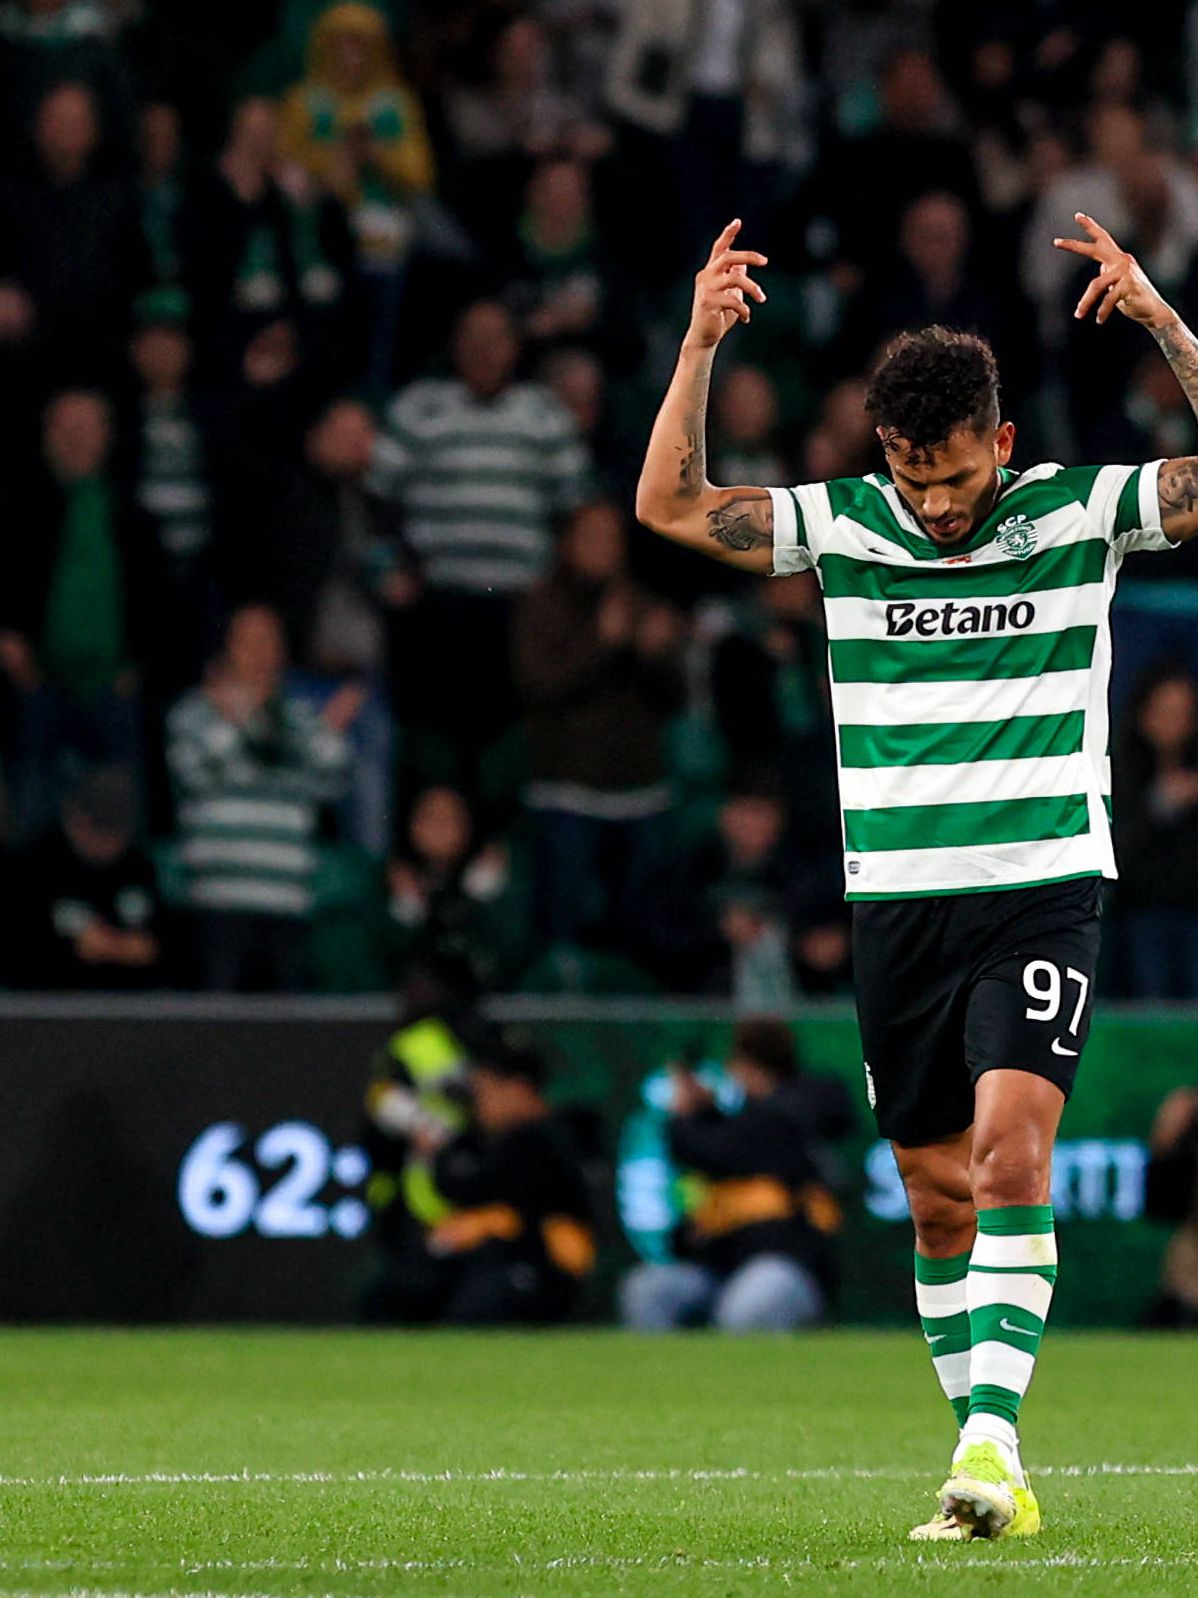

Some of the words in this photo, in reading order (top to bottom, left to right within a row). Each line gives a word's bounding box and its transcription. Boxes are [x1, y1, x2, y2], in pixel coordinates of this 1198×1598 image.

[997, 514, 1026, 533] SCP
[886, 600, 1035, 637] Betano
[1022, 959, 1089, 1037] 97
